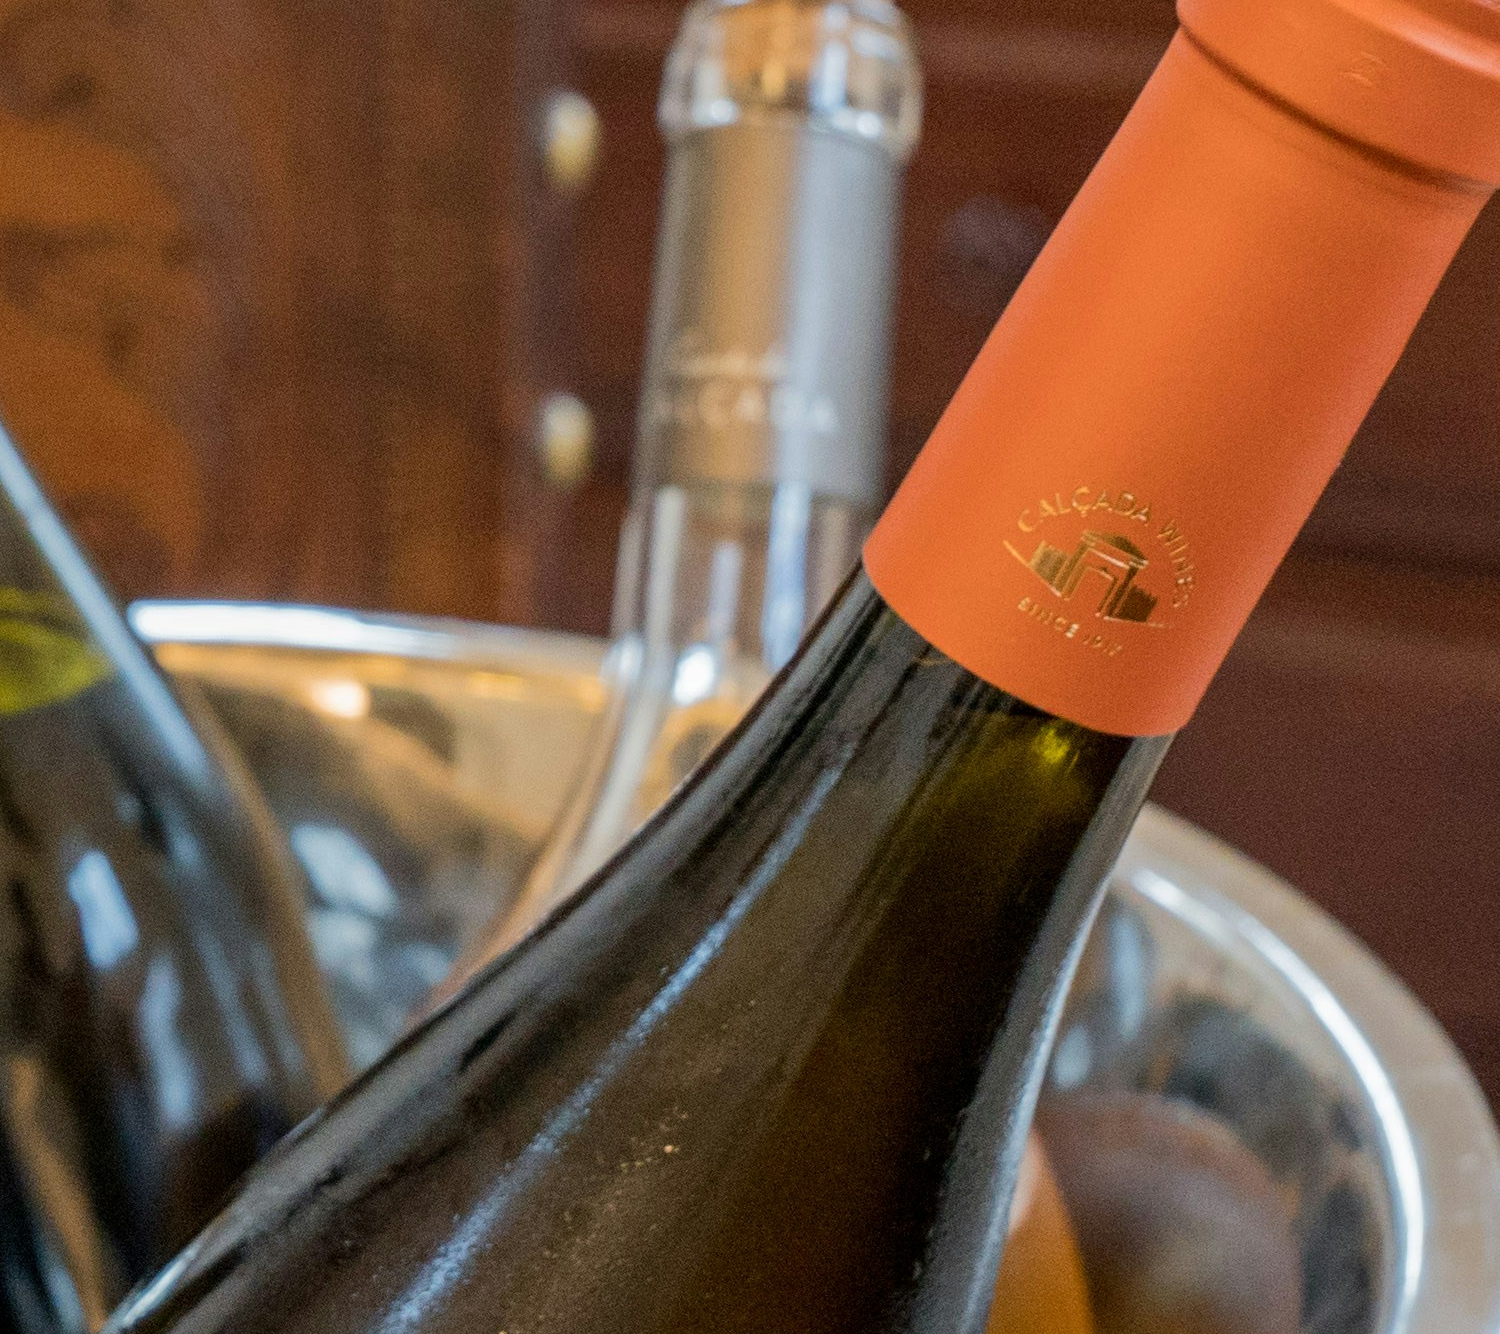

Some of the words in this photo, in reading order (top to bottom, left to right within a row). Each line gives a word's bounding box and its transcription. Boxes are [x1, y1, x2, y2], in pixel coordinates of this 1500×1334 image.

[1017, 485, 1153, 534] CALÇADA
[1156, 517, 1197, 609] WINES
[1017, 596, 1081, 640] SINCE
